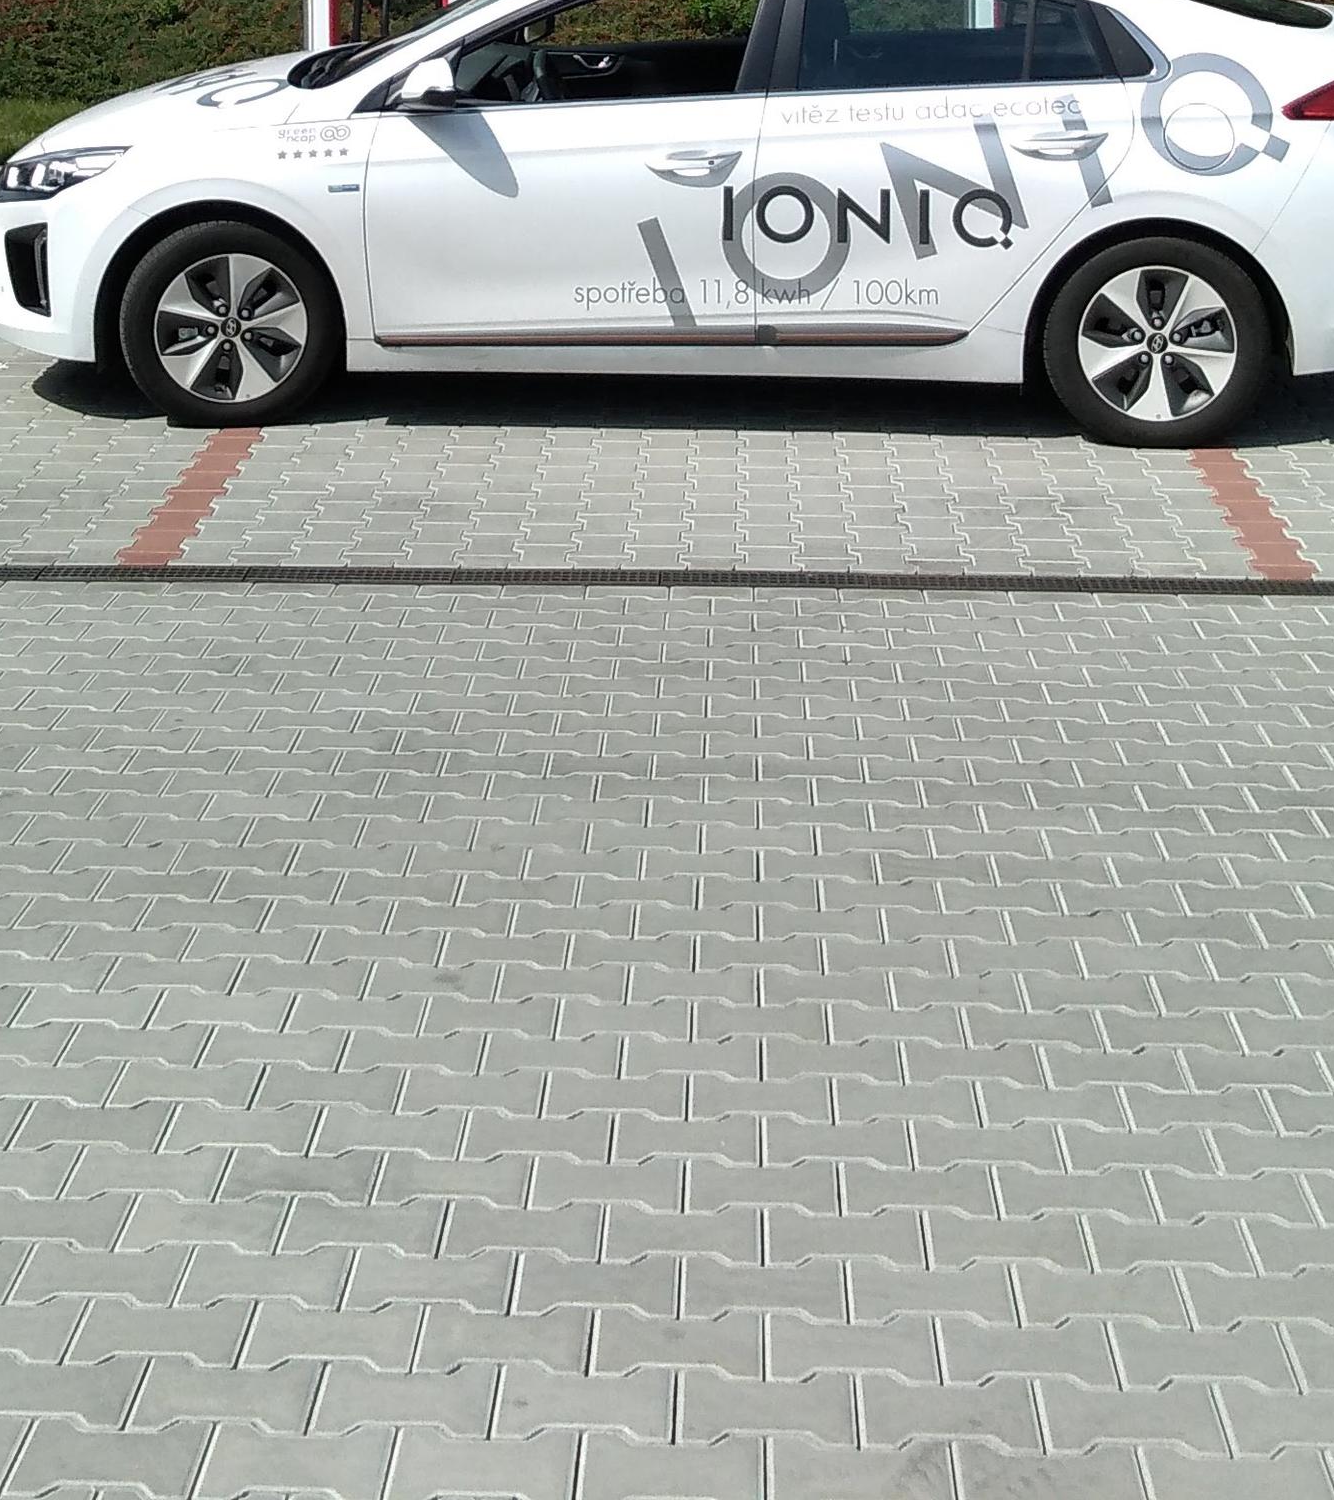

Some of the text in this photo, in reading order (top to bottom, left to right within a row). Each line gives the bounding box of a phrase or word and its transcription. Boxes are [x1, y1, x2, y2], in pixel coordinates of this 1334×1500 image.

[849, 103, 904, 122] testu
[915, 96, 984, 119] adac
[993, 96, 1083, 117] ecotec
[722, 184, 1014, 250] IONIQ
[574, 278, 685, 310] spotřeba
[699, 278, 749, 309] 11,8
[761, 278, 811, 305] kwh
[853, 279, 939, 306] 100km
